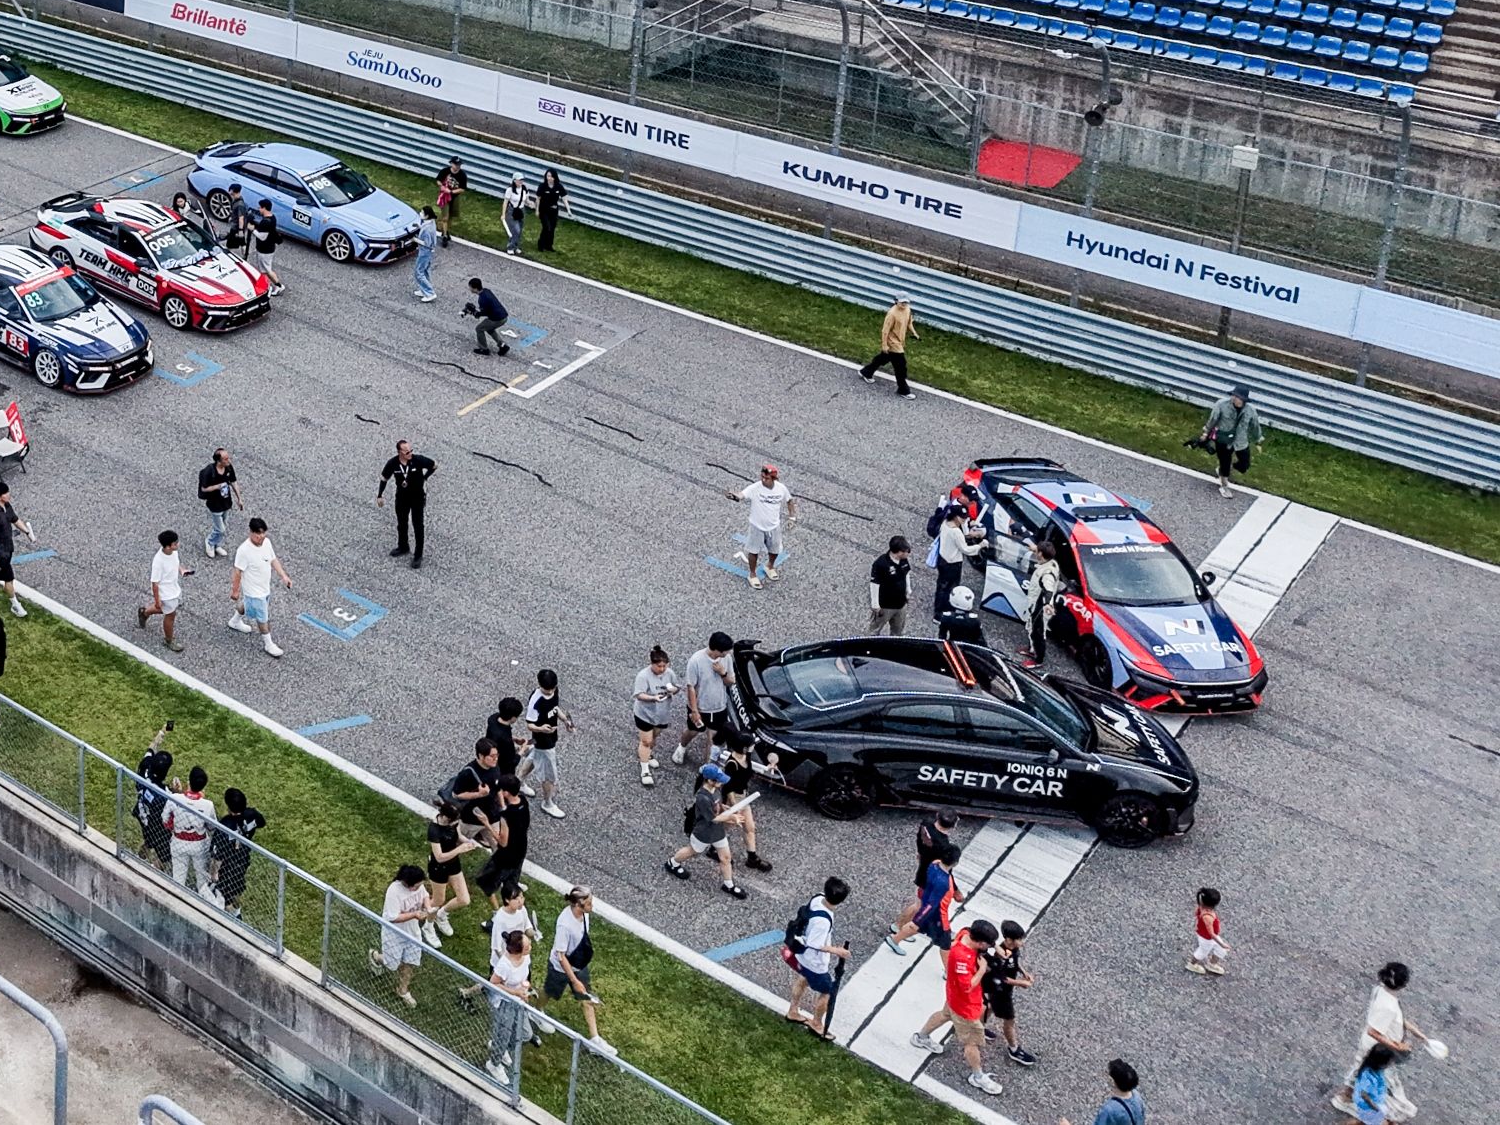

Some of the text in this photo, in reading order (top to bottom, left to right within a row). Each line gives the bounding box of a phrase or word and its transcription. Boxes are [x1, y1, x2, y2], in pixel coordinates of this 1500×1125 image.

[170, 2, 248, 36] Brillantë
[362, 49, 384, 60] JEJU
[346, 50, 443, 90] SamDaSoo
[572, 106, 691, 150] NEXEN TIRE
[308, 177, 332, 192] 106
[783, 160, 964, 219] KUMHO TIRE
[149, 234, 176, 252] 005
[79, 248, 108, 271] TEAM
[1066, 229, 1300, 304] Hyundai N Festival
[137, 277, 155, 295] 005
[24, 291, 44, 308] 83
[8, 334, 25, 351] 83
[1091, 545, 1126, 555] Hyundai
[1135, 544, 1166, 554] Festival
[1152, 641, 1242, 658] SAFETY CAR
[1006, 762, 1068, 779] IONIQ 6 N
[917, 765, 1064, 798] SAFETY CAR
